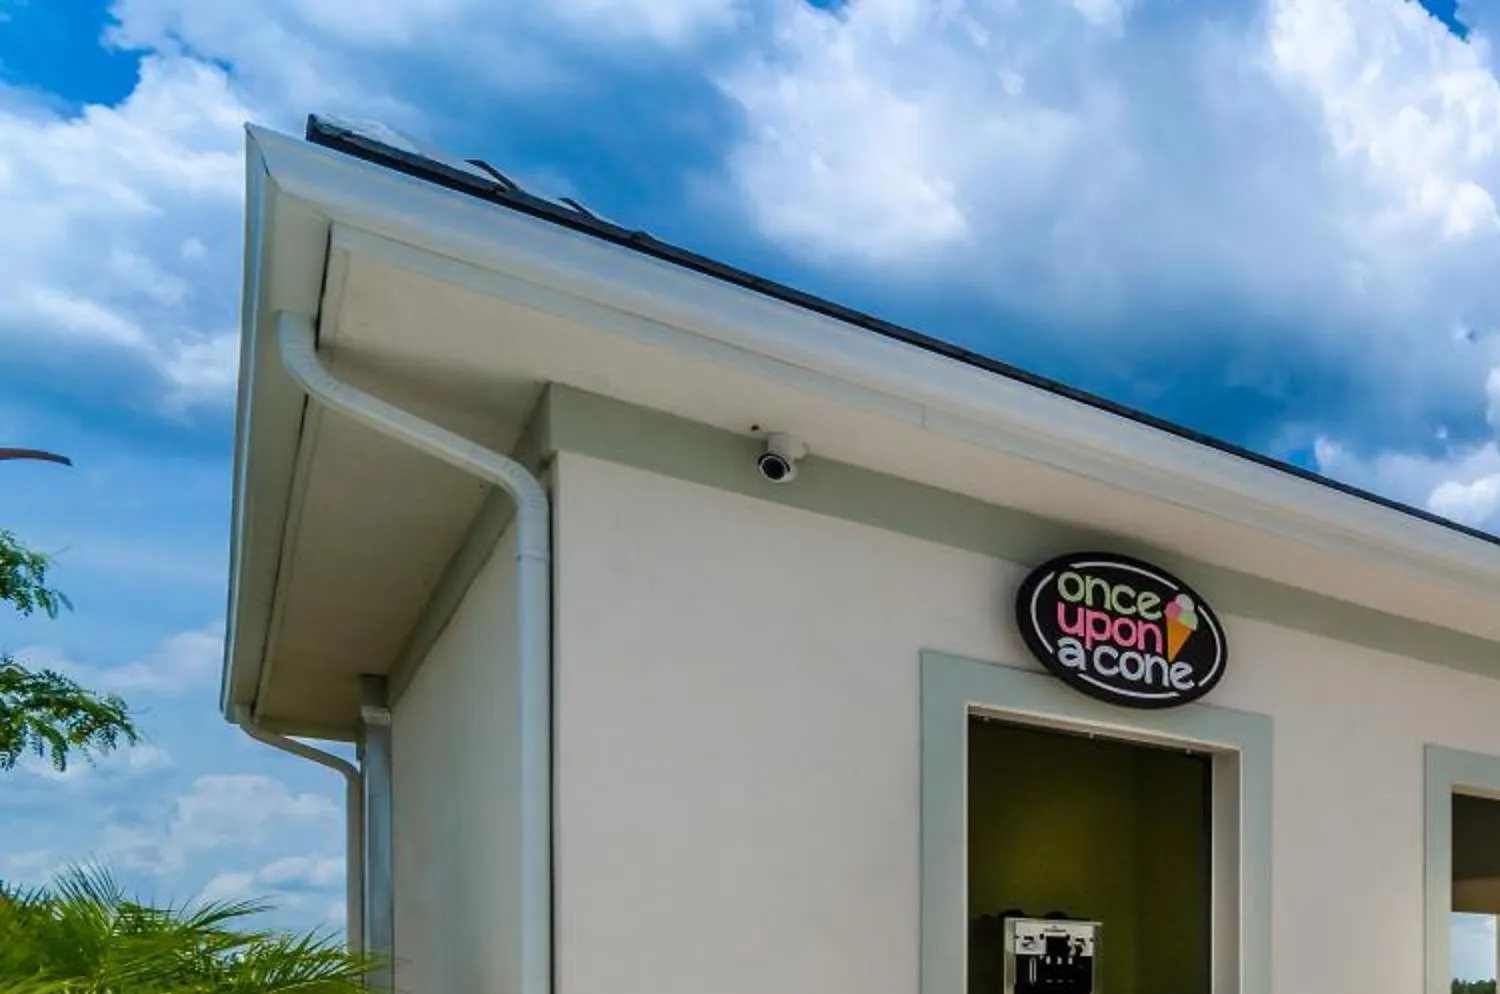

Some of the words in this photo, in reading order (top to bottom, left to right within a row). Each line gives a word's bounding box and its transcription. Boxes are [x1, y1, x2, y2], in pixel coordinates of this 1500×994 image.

[1056, 571, 1163, 620] once
[1056, 600, 1164, 654] upon
[1056, 636, 1087, 671] a
[1092, 645, 1196, 690] cone
